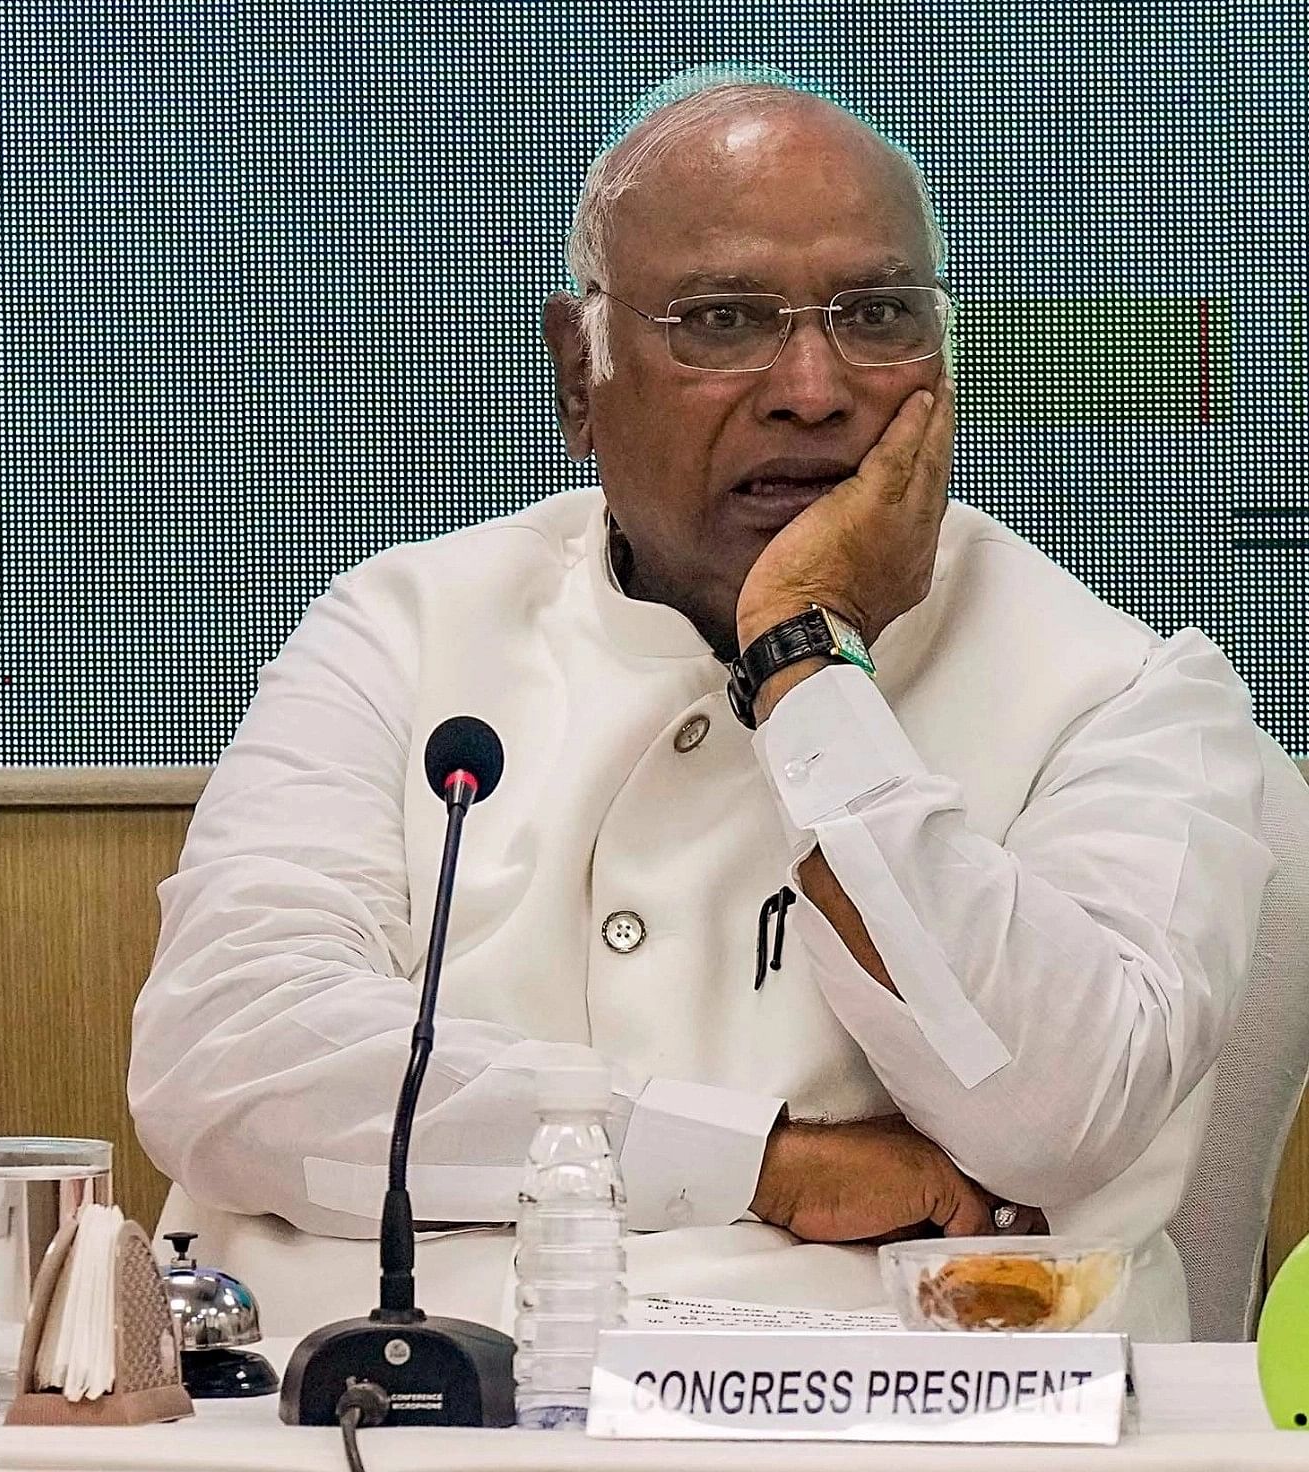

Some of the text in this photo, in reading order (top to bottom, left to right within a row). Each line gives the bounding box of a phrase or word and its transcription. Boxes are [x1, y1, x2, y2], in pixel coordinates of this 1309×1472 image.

[391, 1393, 443, 1401] CONFERENCE
[632, 1370, 1093, 1415] CONGRESS PRESIDENT
